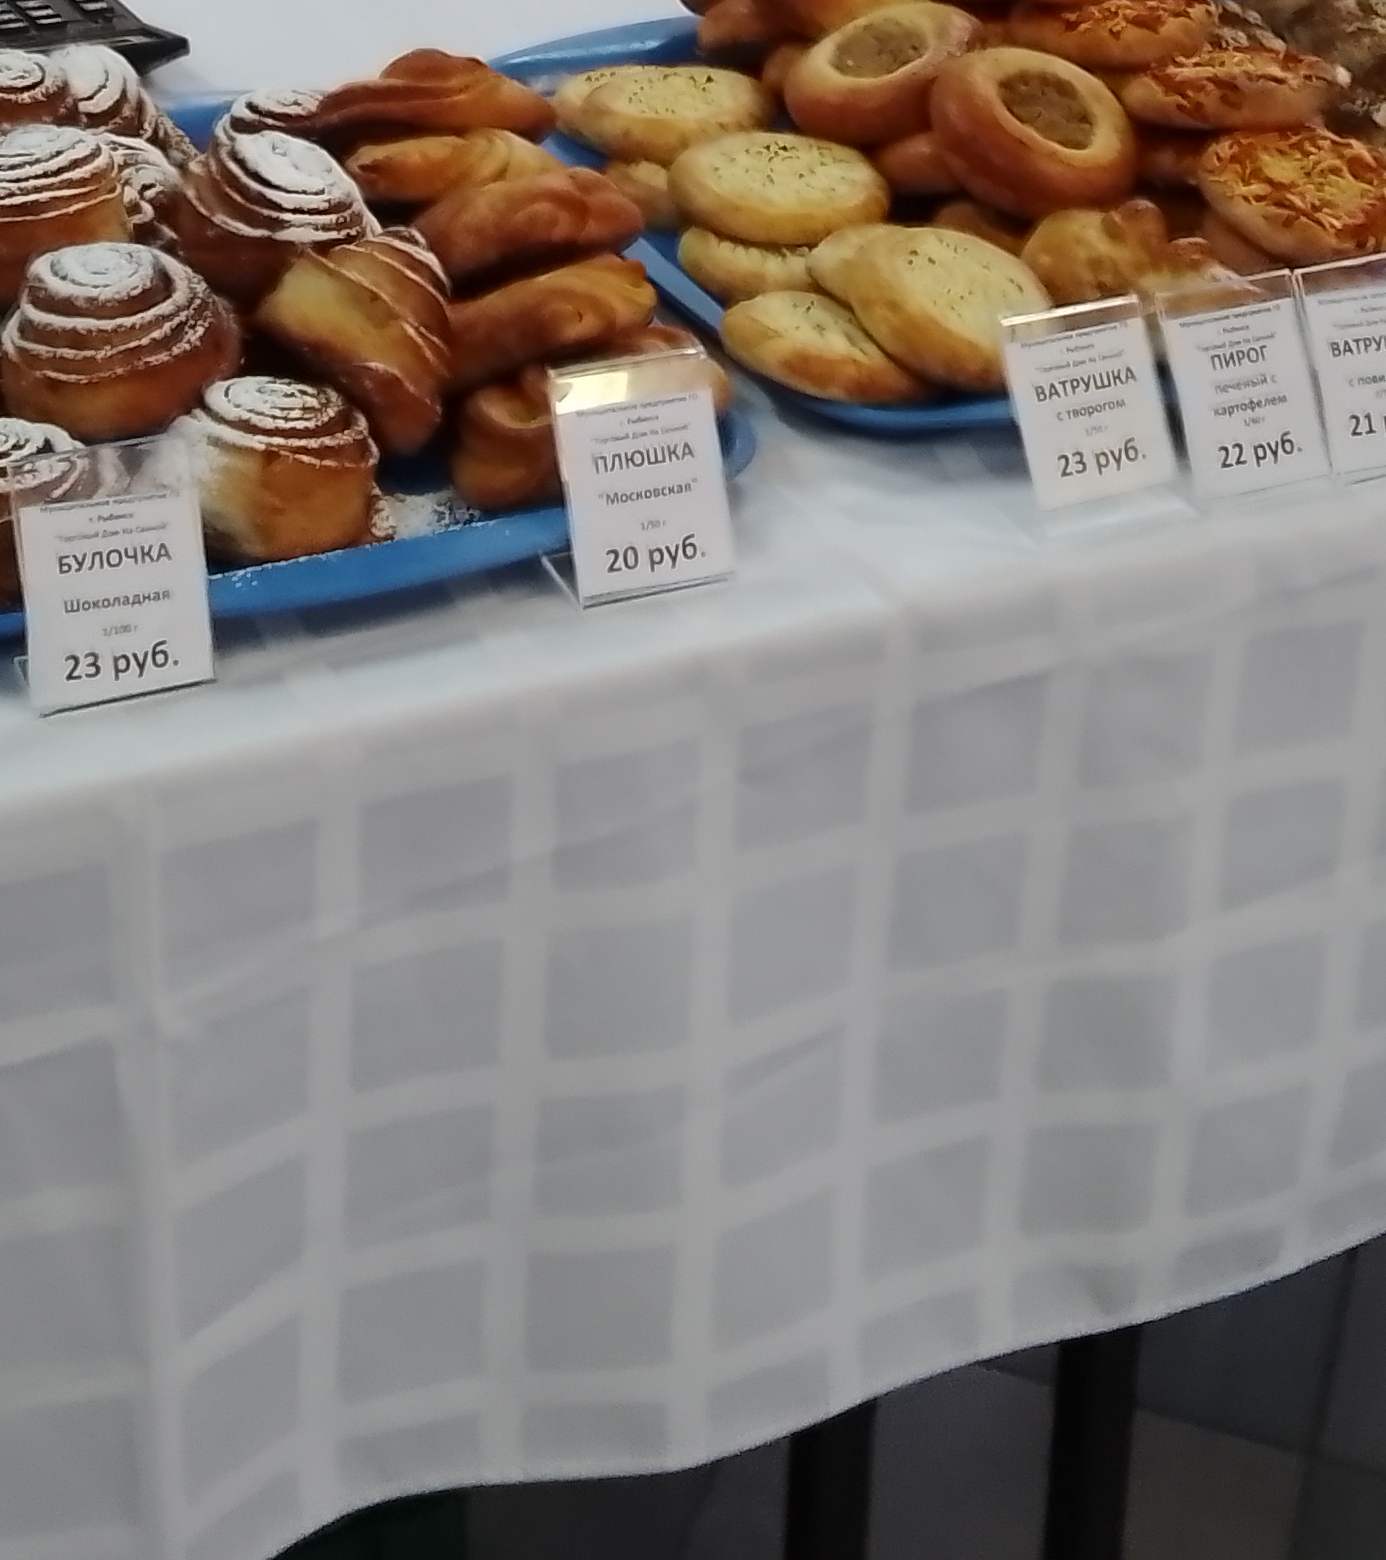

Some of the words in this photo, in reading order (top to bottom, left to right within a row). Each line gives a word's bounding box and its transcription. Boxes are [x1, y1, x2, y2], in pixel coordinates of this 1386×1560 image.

[1209, 344, 1268, 372] ПИРОГ
[1033, 365, 1139, 404] ВАТРУШКА
[1065, 397, 1127, 421] творогом
[1348, 410, 1378, 438] 21
[593, 441, 696, 475] ПЛЮШКА
[1056, 450, 1088, 479] 23
[1093, 436, 1148, 477] руб.
[1217, 442, 1248, 470] 22
[1252, 430, 1304, 469] руб.
[598, 477, 699, 507] "Московская"
[57, 542, 173, 576] БУЛОЧКА
[605, 545, 640, 574] 20
[648, 533, 708, 574] руб.
[63, 589, 171, 615] Шоколадная
[64, 651, 103, 683] 23
[112, 639, 181, 682] руб.
